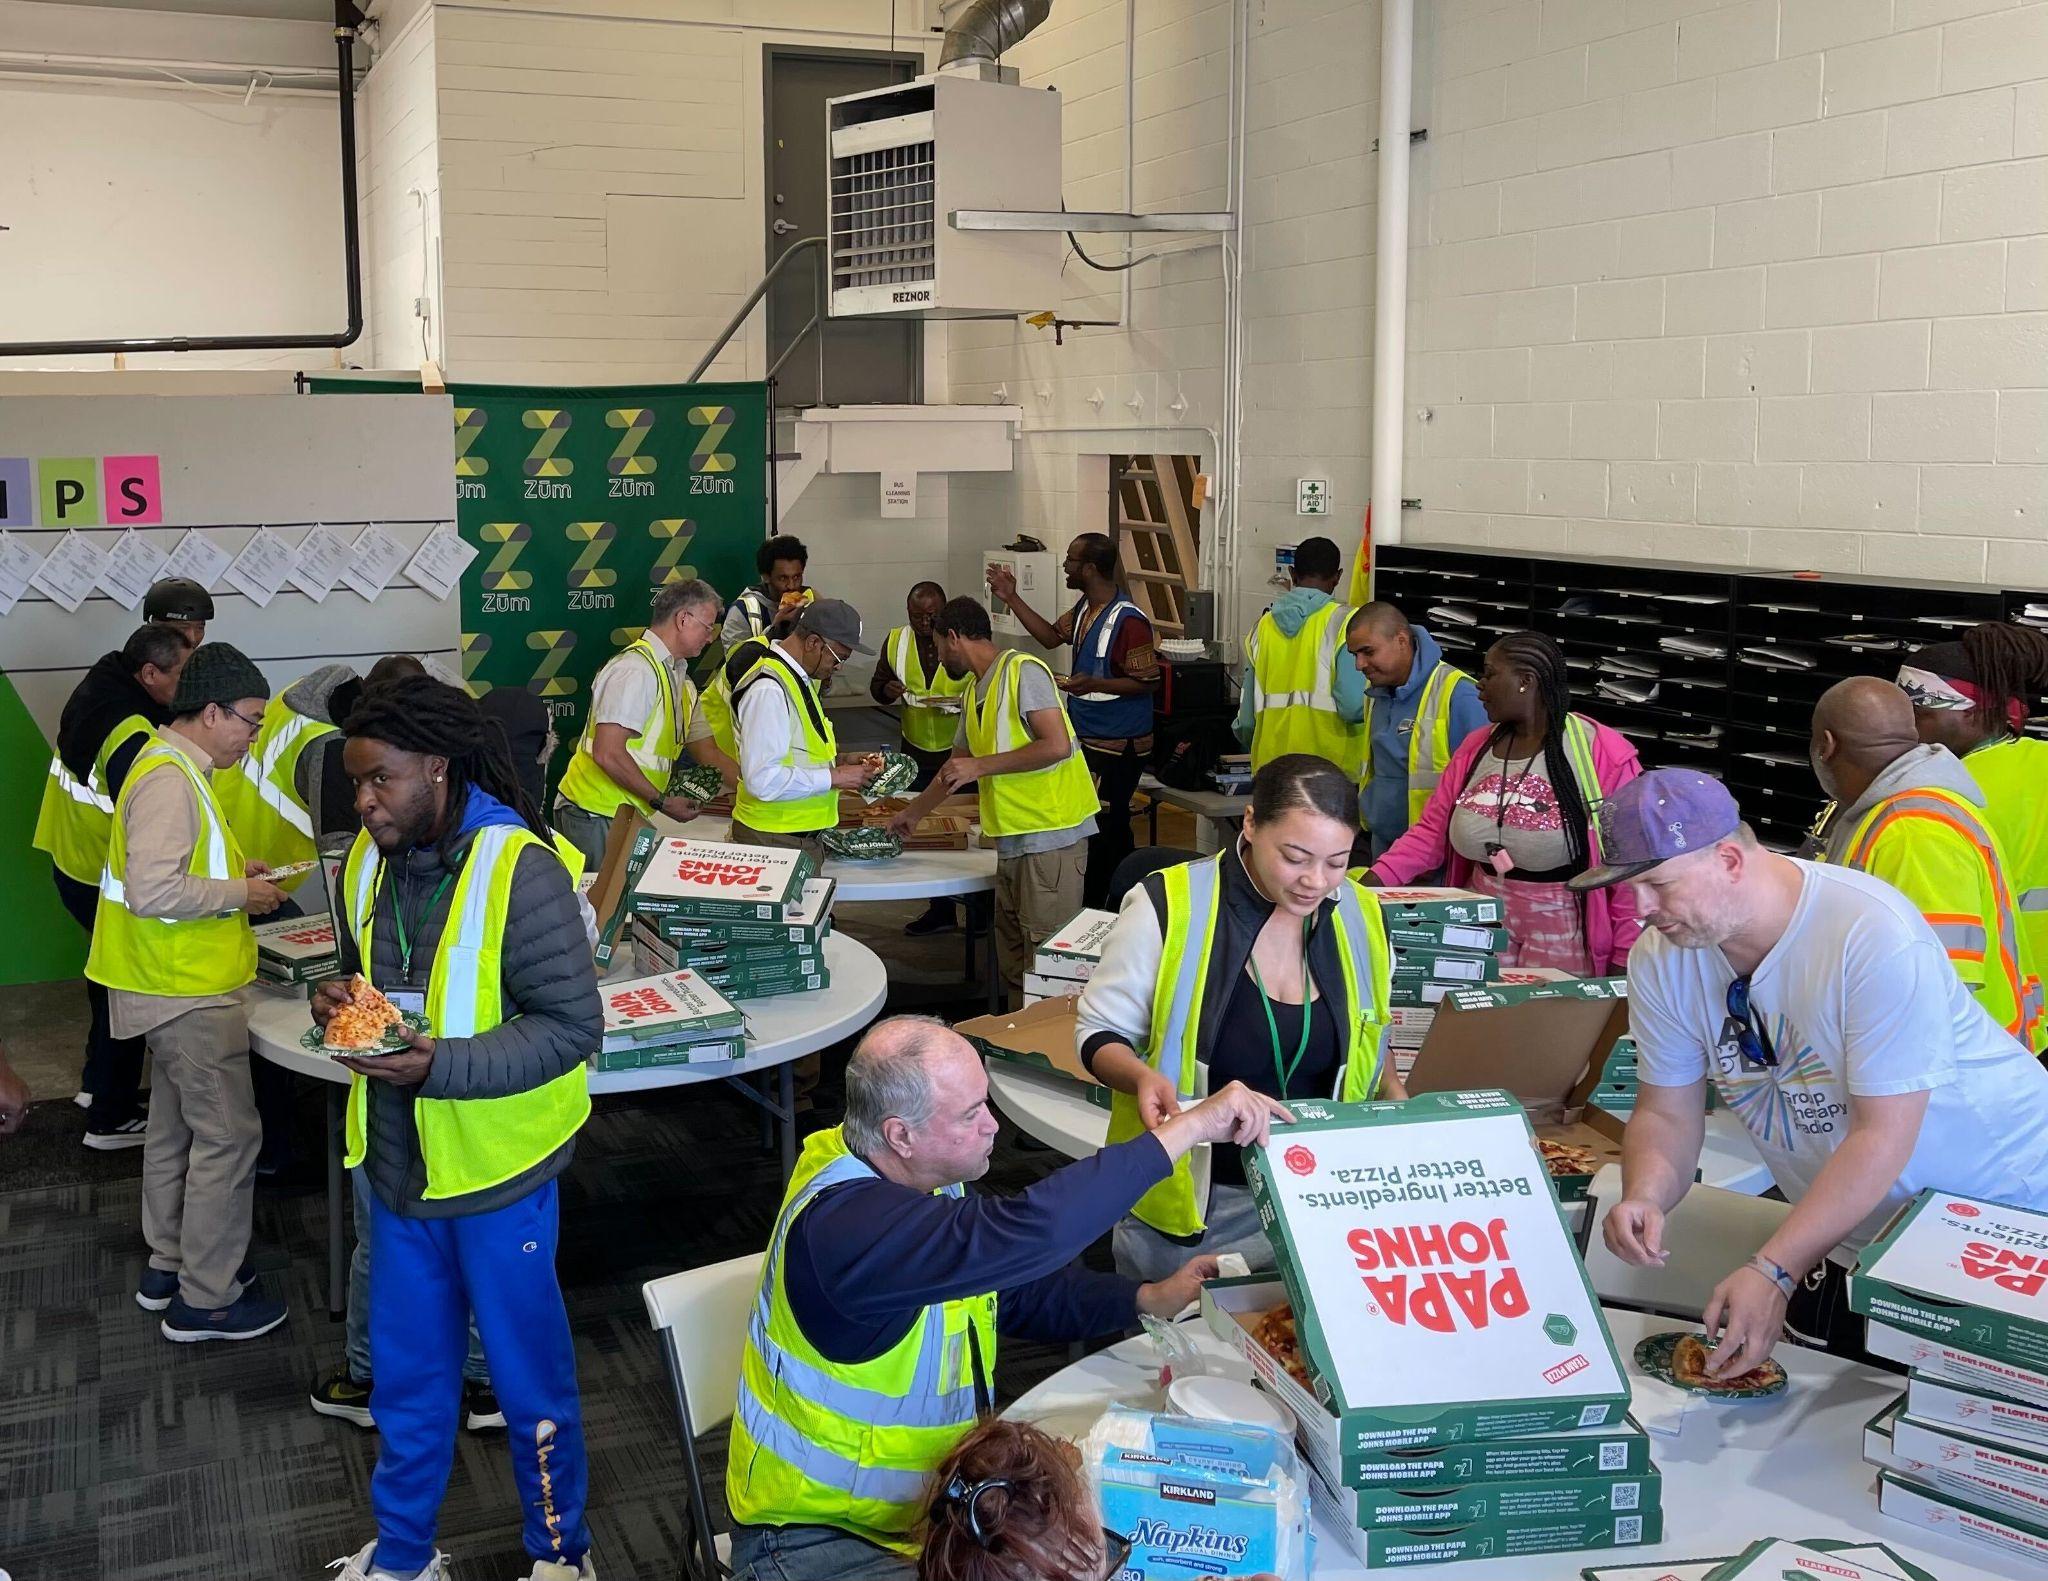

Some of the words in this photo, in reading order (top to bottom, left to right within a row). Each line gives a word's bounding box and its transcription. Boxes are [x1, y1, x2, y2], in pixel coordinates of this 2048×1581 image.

[892, 290, 930, 303] REZNOR
[456, 479, 486, 499] ūm
[524, 480, 572, 499] Zūm
[609, 478, 655, 497] Zūm
[690, 475, 734, 494] Zūm
[482, 593, 530, 612] Zūm
[568, 591, 614, 610] Zūm
[548, 699, 575, 717] ūm
[679, 859, 767, 874] JOHNS
[677, 869, 760, 886] PAPA
[610, 991, 654, 1019] PAPA
[634, 987, 678, 1015] JOHNS
[1329, 1165, 1402, 1185] Pizza.
[1407, 1158, 1487, 1179] Better
[1298, 1182, 1448, 1211] Ingredients.
[1452, 1177, 1533, 1199] Better
[1346, 1217, 1511, 1271] JOHNS
[1960, 1255, 2047, 1297] PA
[1361, 1267, 1532, 1334] PAPA
[1869, 1306, 1900, 1319] JOHNS
[1900, 1313, 1932, 1328] MOBILE
[1933, 1321, 1952, 1333] APP
[1870, 1297, 1919, 1317] DOWNLOAD
[1920, 1310, 1936, 1320] THE
[1937, 1314, 1961, 1328] PAPA
[1567, 1355, 1589, 1373] TEAM
[1942, 1350, 1957, 1360] WE
[1957, 1354, 1978, 1366] LOVE
[1978, 1360, 2003, 1374] PIZZA
[1544, 1366, 1568, 1384] PIZZA
[1992, 1404, 2007, 1415] WE
[2007, 1408, 2031, 1420] LOVE
[1357, 1440, 1384, 1450] JOHNS
[1384, 1437, 1414, 1447] MOBILE
[1413, 1435, 1429, 1444] APP
[1358, 1429, 1402, 1441] DOWNLOAD
[1402, 1428, 1417, 1436] THE
[1417, 1426, 1437, 1435] PAPA
[1360, 1462, 1407, 1472] DOWNLOAD
[1407, 1462, 1422, 1470] THE
[1423, 1461, 1445, 1469] PAPA
[1975, 1450, 1989, 1460] WE
[1990, 1454, 2012, 1466] LOVE
[2014, 1460, 2040, 1473] PIZZA
[1359, 1472, 1388, 1480] JOHNS
[1389, 1470, 1419, 1479] MOBILE
[1420, 1470, 1437, 1478] APP
[1162, 1484, 1215, 1500] KIRKLAND
[1998, 1483, 2010, 1493] AS
[1375, 1505, 1422, 1514] DOWNLOAD
[1422, 1504, 1437, 1512] THE
[1438, 1503, 1459, 1511] PAPA
[1375, 1514, 1404, 1523] JOHNS
[1404, 1513, 1434, 1521] MOBILE
[1434, 1512, 1451, 1520] APP
[1127, 1517, 1250, 1554] Napkins
[1959, 1514, 1972, 1525] WE
[1973, 1519, 1995, 1532] LOVE
[1996, 1527, 2021, 1541] PIZZA
[1179, 1546, 1209, 1556] CASUAL
[1211, 1550, 1237, 1560] DINING
[1385, 1544, 1430, 1555] DOWNLOAD
[1431, 1543, 1445, 1551] THE
[1446, 1541, 1467, 1549] PAPA
[1385, 1554, 1413, 1563] JOHNS
[1413, 1552, 1442, 1560] MOBILE
[1443, 1550, 1459, 1558] APP
[1166, 1557, 1193, 1566] absorbent
[1194, 1560, 1204, 1568] and
[1205, 1563, 1223, 1573] strong
[1799, 1559, 1827, 1572] TEAM
[1828, 1565, 1860, 1579] PIZZA
